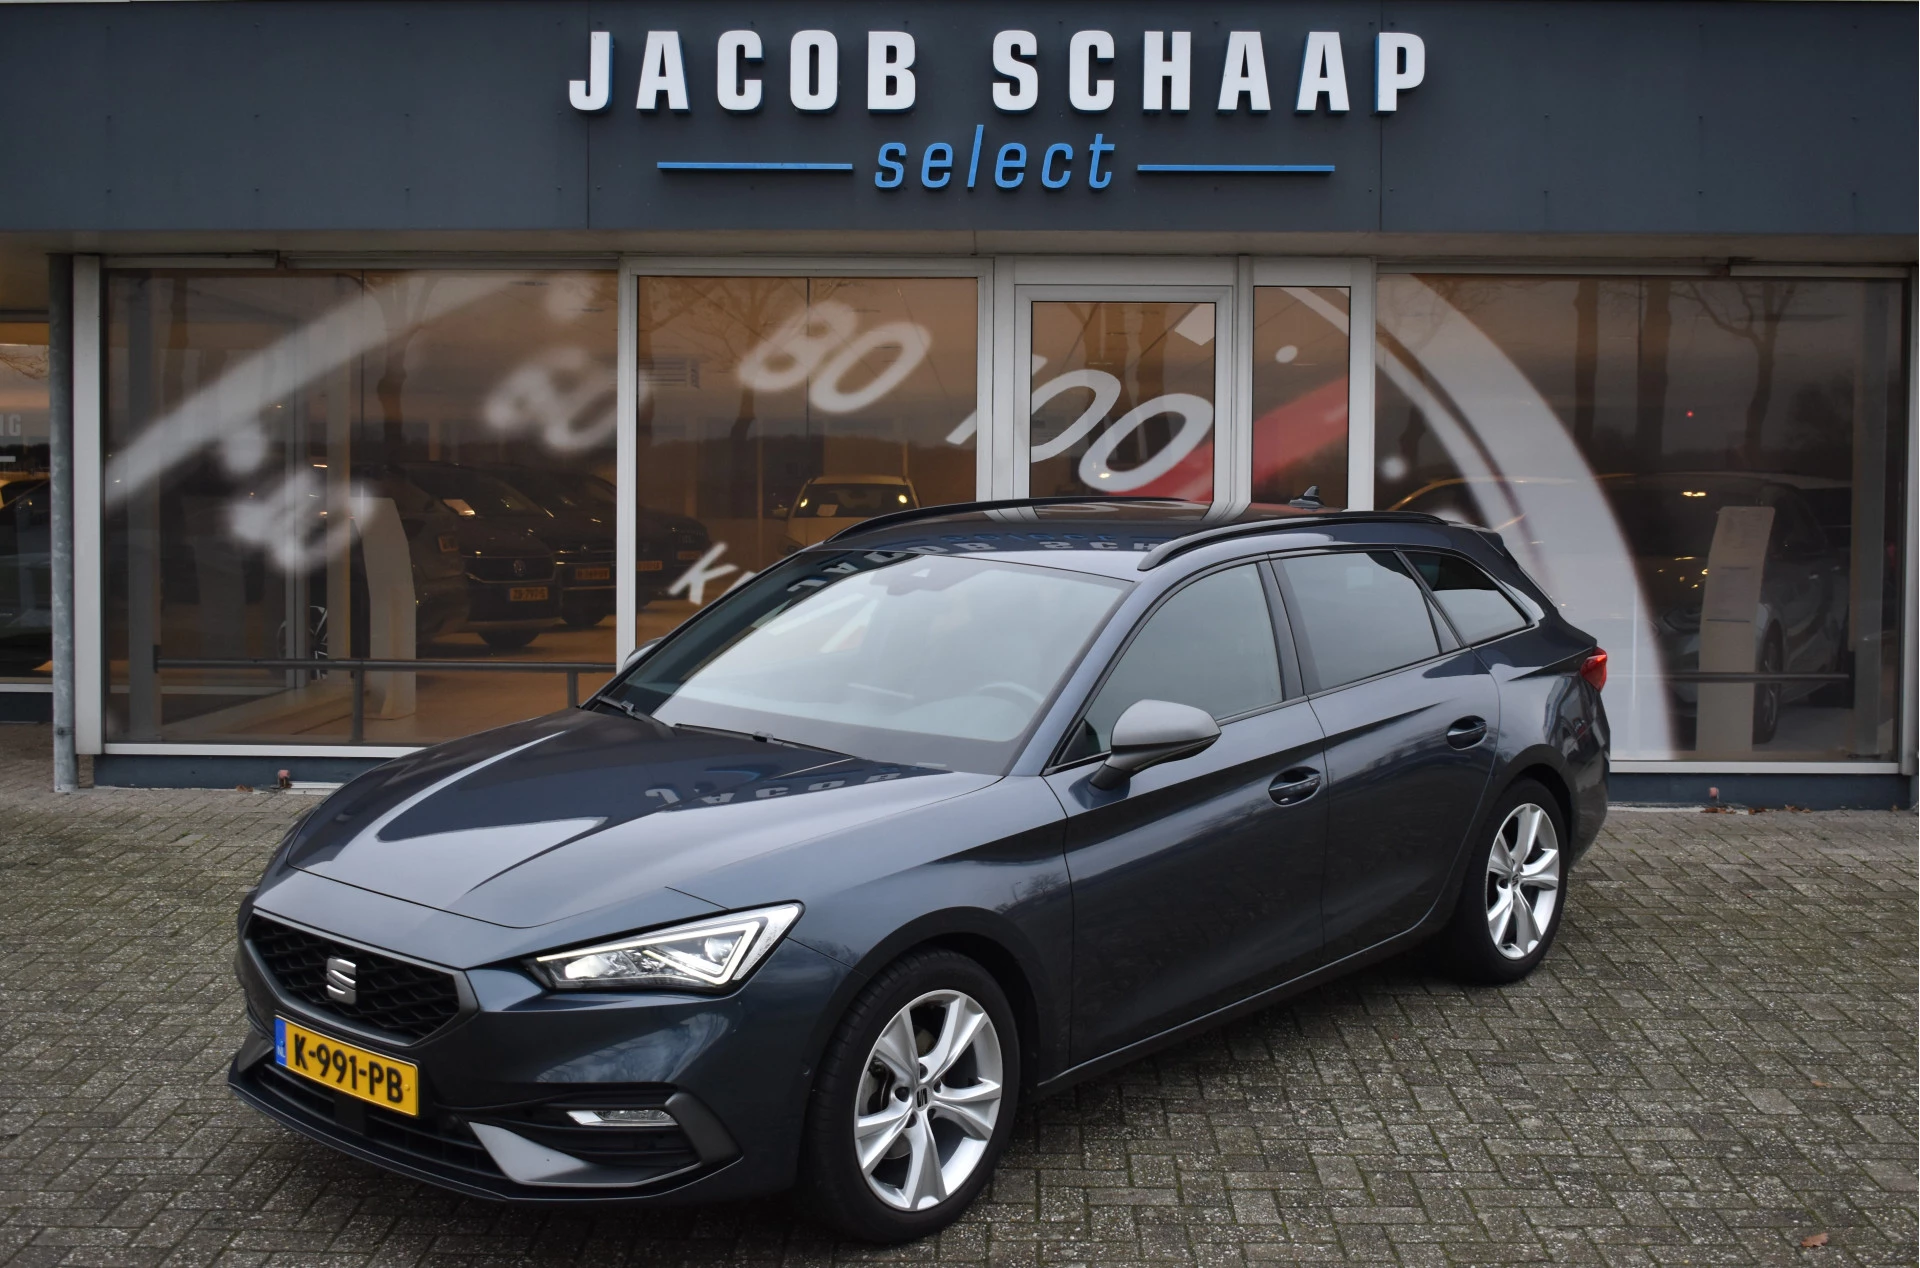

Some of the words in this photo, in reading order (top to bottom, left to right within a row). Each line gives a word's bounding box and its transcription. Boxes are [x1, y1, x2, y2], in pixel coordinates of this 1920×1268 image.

[569, 30, 917, 113] JACOB
[992, 30, 1426, 114] SCHAAP
[875, 124, 1116, 191] select
[736, 300, 933, 415] 80
[294, 1033, 404, 1104] K-991-PB
